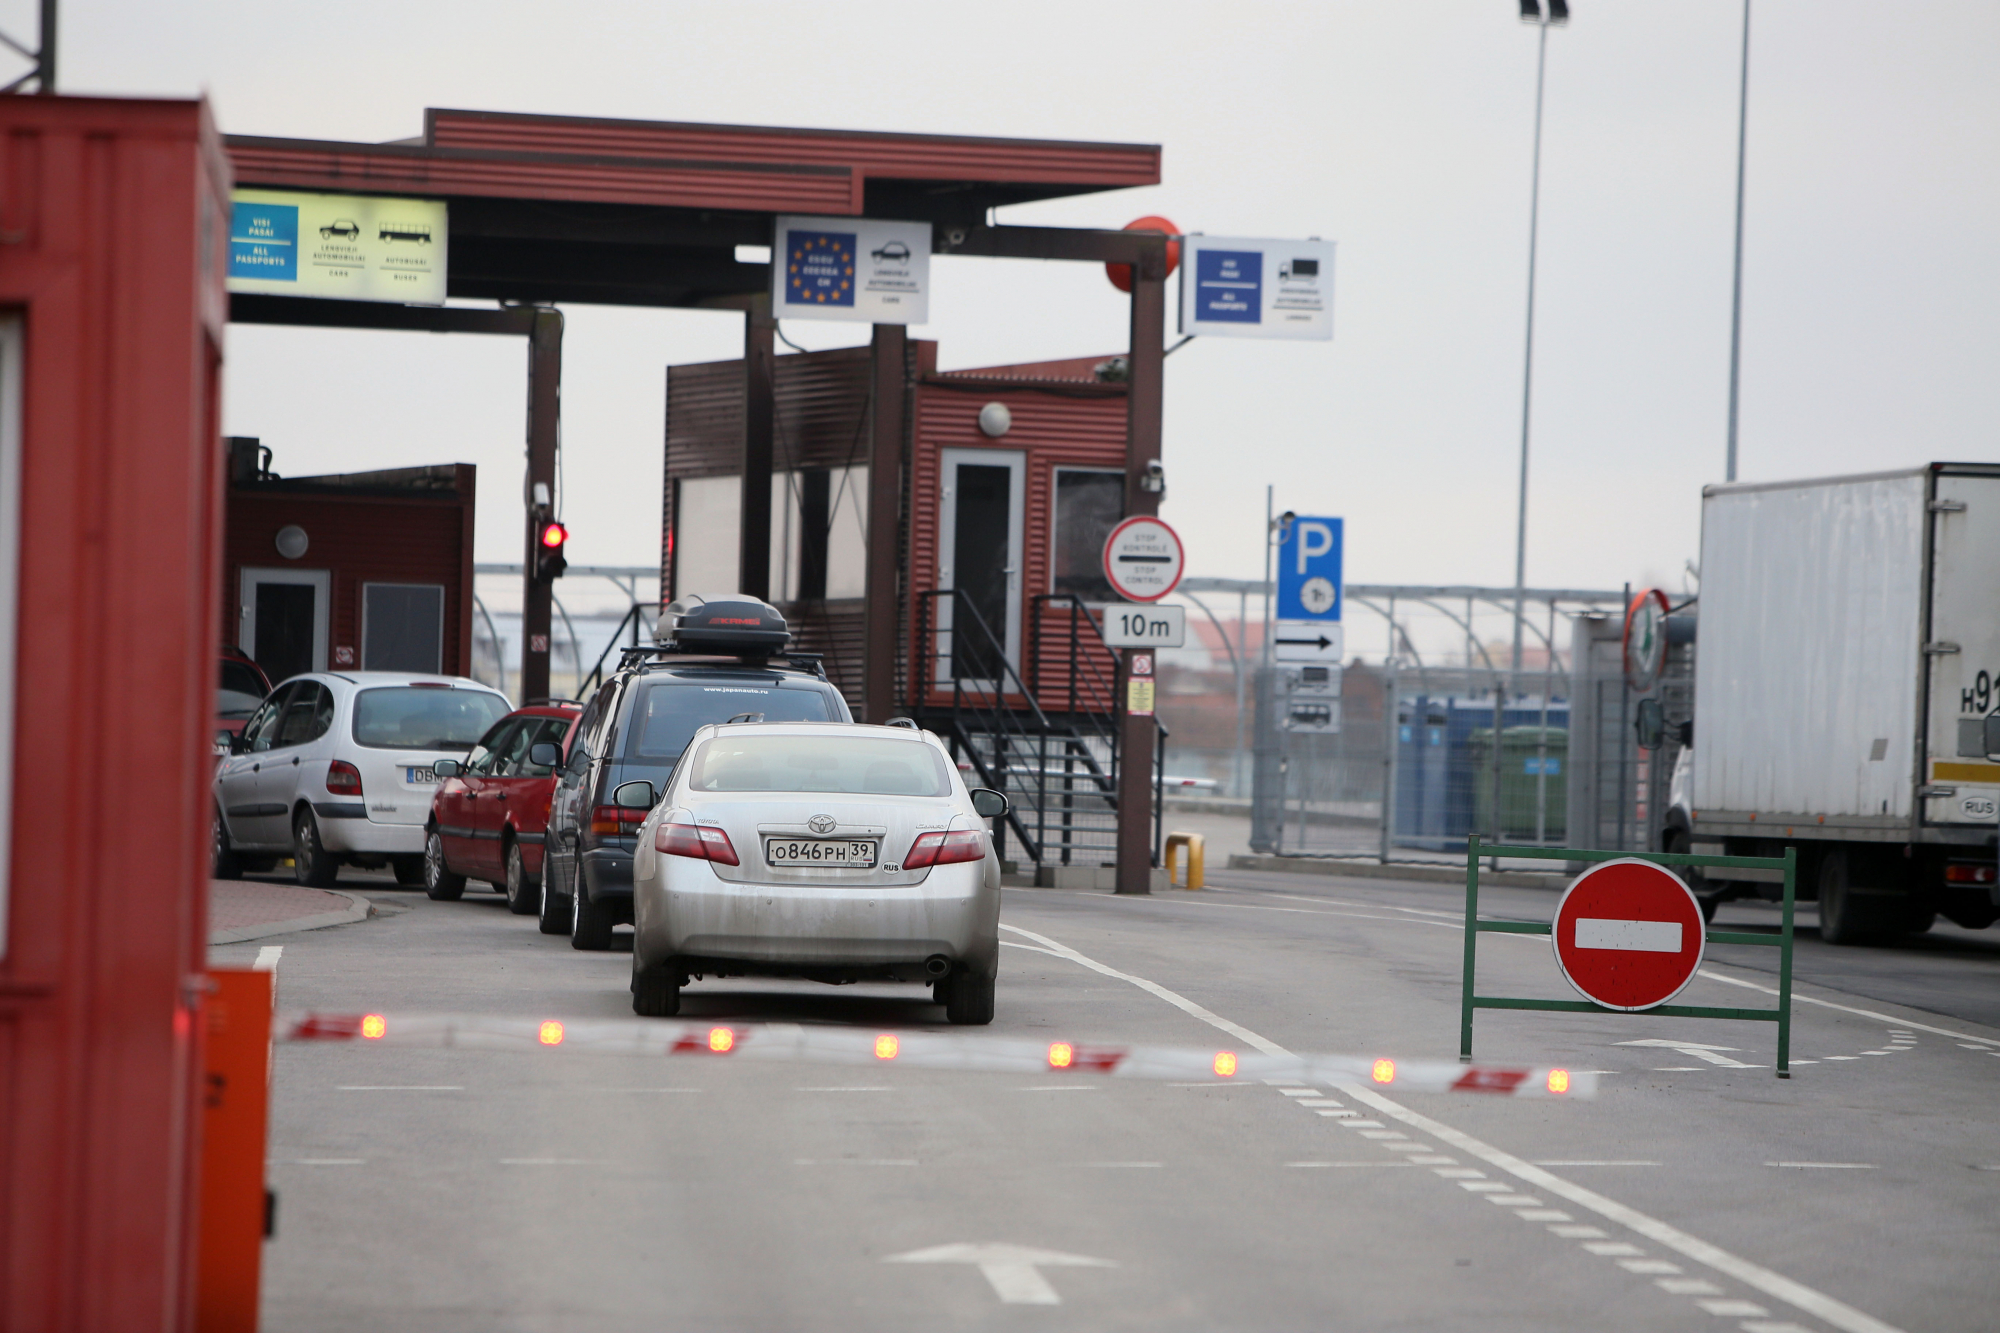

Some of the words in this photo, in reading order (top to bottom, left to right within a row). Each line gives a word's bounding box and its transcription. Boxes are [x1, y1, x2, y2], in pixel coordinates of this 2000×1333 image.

[253, 218, 270, 227] VISI
[248, 227, 274, 237] PASAI
[253, 246, 268, 256] ALL
[236, 254, 285, 266] PASSPORTS
[1135, 534, 1157, 542] STOP
[1297, 522, 1333, 575] P
[1134, 566, 1157, 574] STOP
[1125, 576, 1164, 585] CONTROL
[1121, 614, 1146, 636] 10
[1150, 621, 1169, 636] m
[703, 687, 769, 695] www.japanauto.ru
[1965, 801, 1995, 814] RUS
[851, 843, 868, 857] 39
[883, 864, 899, 872] RUS
